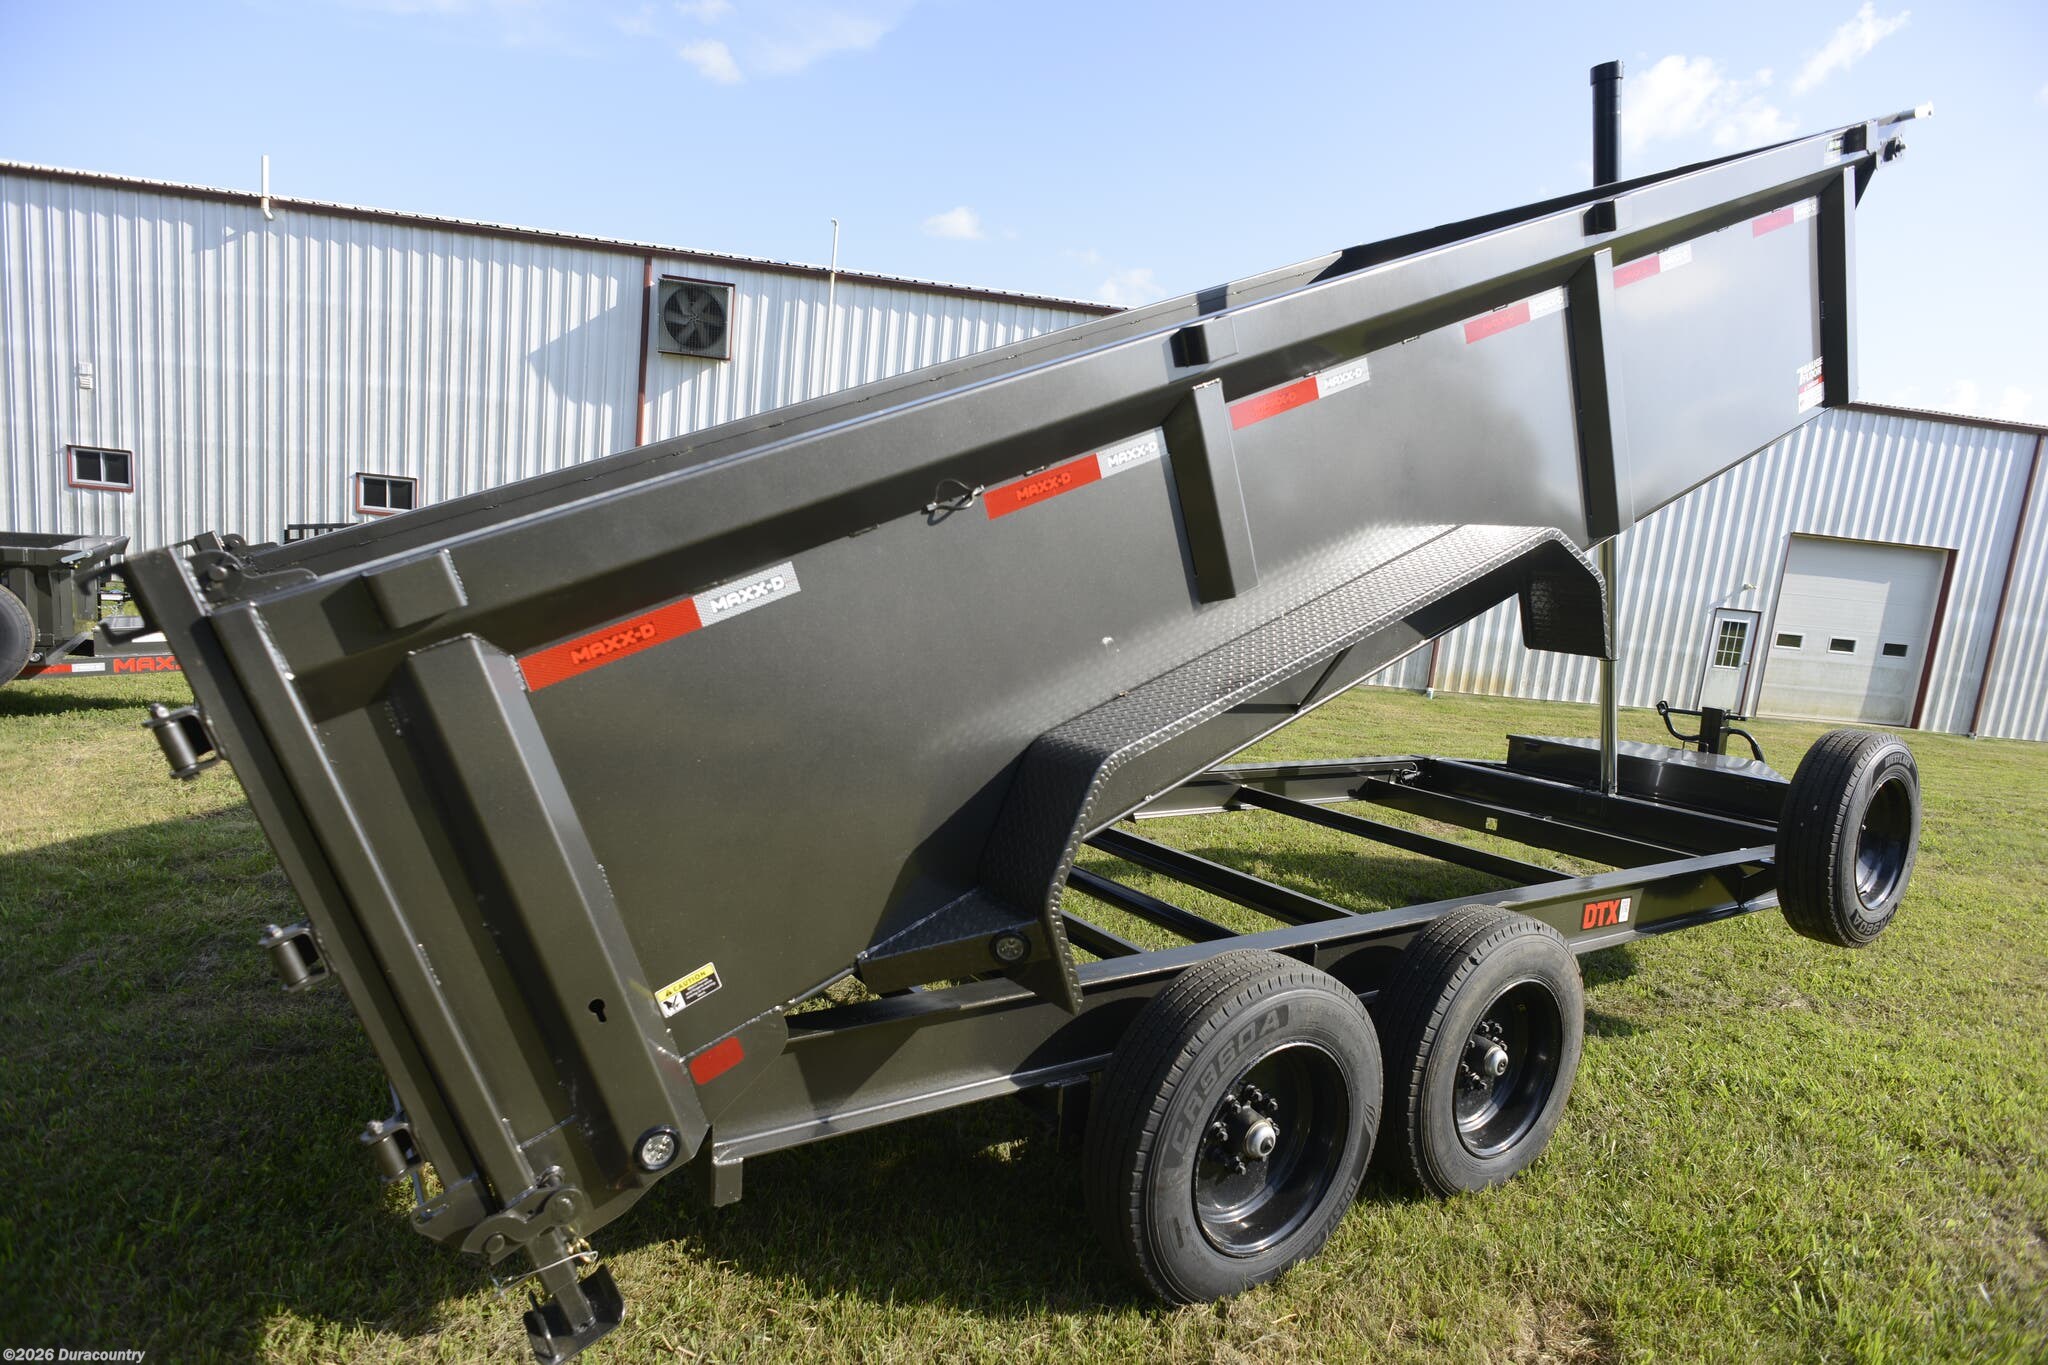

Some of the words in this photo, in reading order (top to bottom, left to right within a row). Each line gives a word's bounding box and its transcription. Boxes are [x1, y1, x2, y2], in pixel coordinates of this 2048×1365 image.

[1324, 367, 1363, 388] MAXX-D
[1108, 442, 1158, 468] MAXX-D
[1016, 471, 1072, 501] MAXX-D
[710, 576, 785, 612] MAXX-D
[570, 623, 656, 665] MAXX-D
[113, 656, 182, 674] MAX
[1582, 899, 1621, 930] DTX
[673, 971, 706, 992] CAUTION
